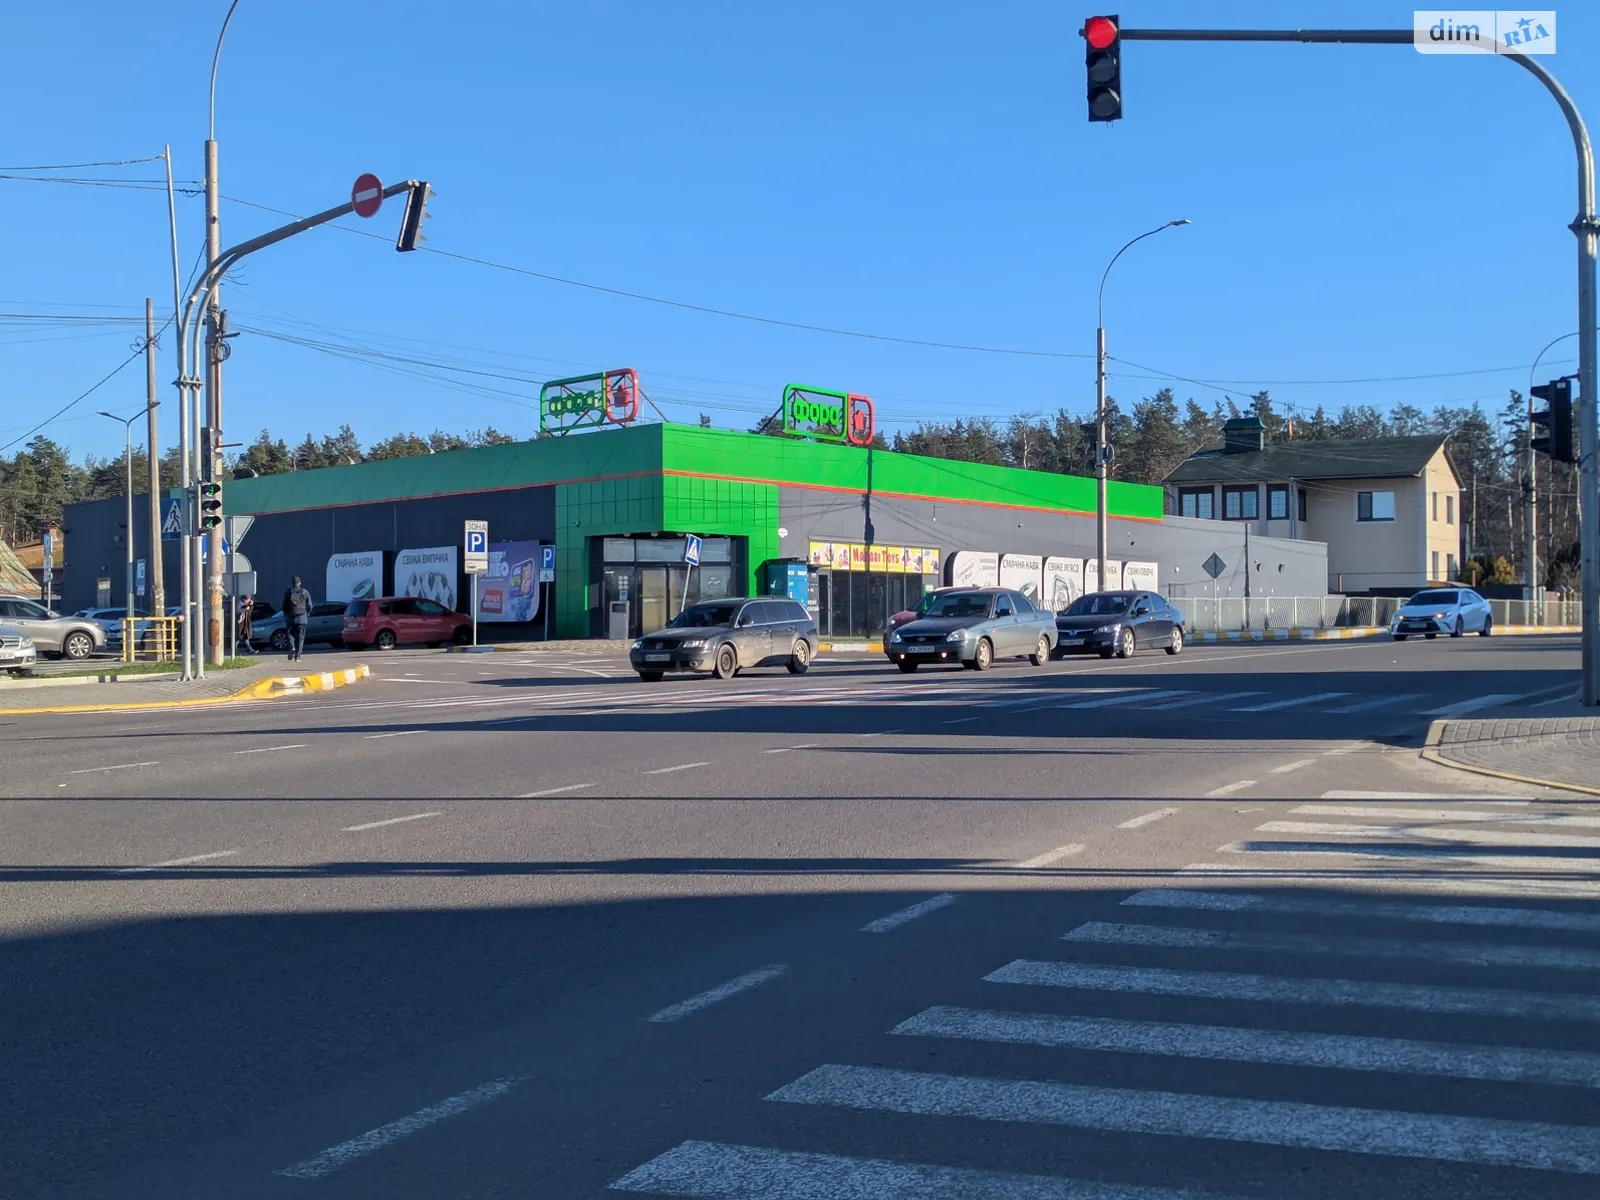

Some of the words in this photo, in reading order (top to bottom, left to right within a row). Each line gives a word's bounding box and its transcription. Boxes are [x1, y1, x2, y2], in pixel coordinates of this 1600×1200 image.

[467, 522, 487, 531] ЗОНА
[334, 558, 358, 569] СМАЧНА
[358, 556, 374, 568] КАВА
[1003, 559, 1026, 570] СМАЧНА
[1025, 560, 1039, 571] КАВА
